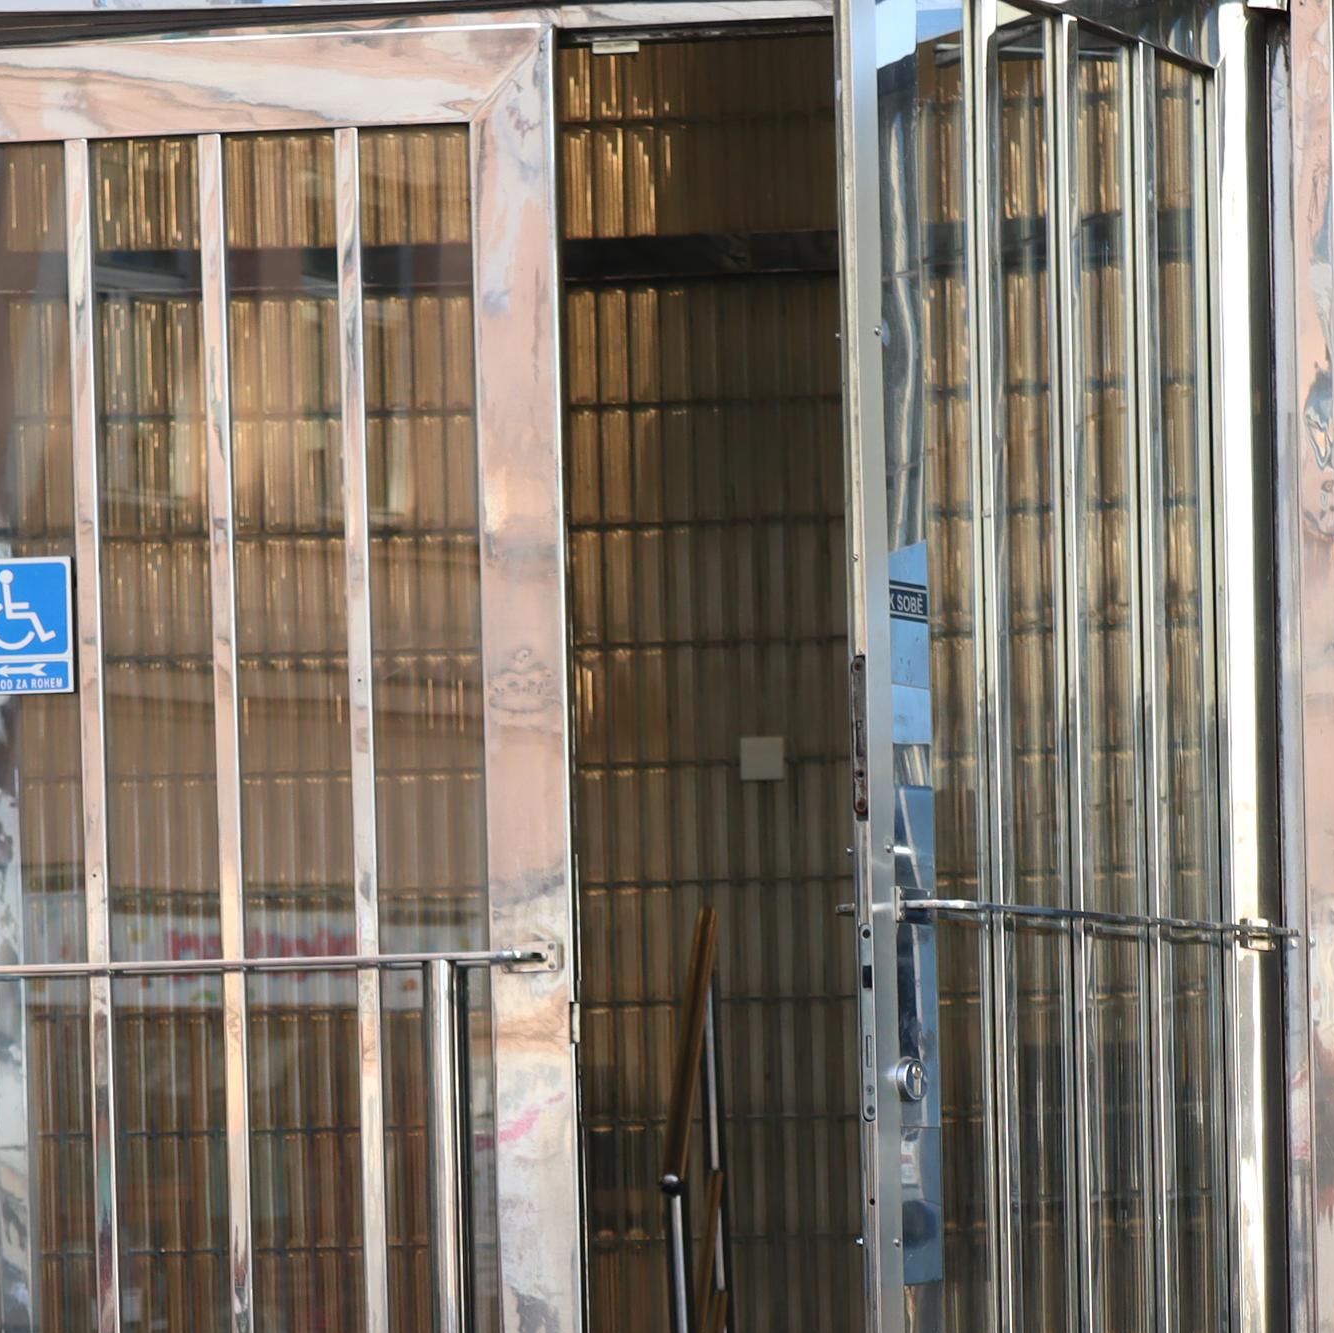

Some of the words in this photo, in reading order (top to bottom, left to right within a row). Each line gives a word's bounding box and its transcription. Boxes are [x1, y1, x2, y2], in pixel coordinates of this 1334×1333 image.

[897, 593, 924, 615] SOBĚ
[15, 678, 29, 689] ZA
[31, 676, 63, 689] ROHEM
